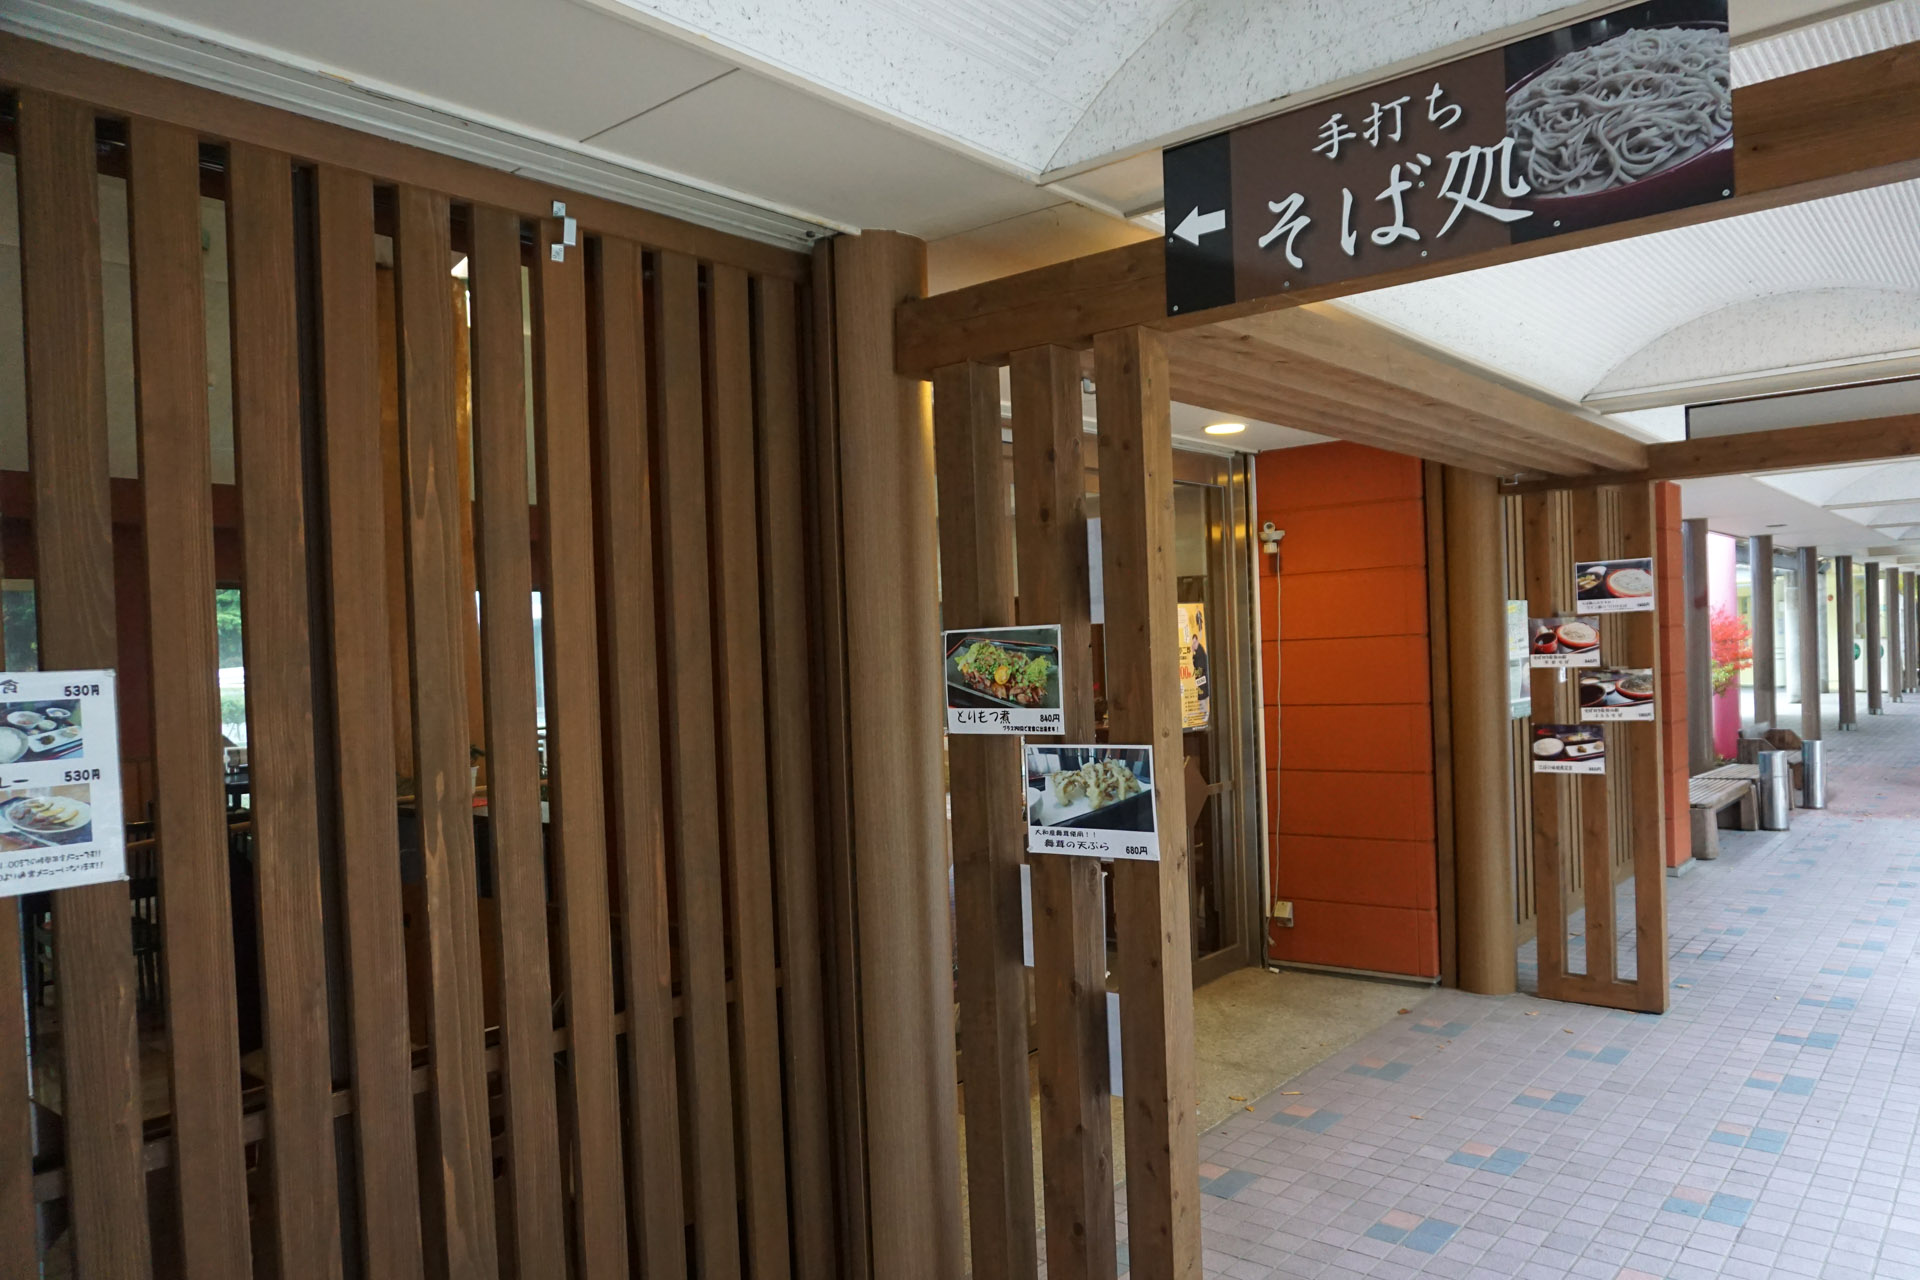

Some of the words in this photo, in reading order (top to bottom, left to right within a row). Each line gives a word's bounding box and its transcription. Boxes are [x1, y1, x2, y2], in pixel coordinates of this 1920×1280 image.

[1311, 82, 1462, 160] 手打ち
[1258, 136, 1534, 269] そば処
[64, 684, 100, 697] 530円
[956, 710, 1011, 724] とりもつ煮
[1039, 713, 1060, 723] 840円
[64, 768, 100, 782] 530円
[1044, 838, 1110, 851] 舞茸の天ぷら
[1125, 846, 1148, 856] 680円
